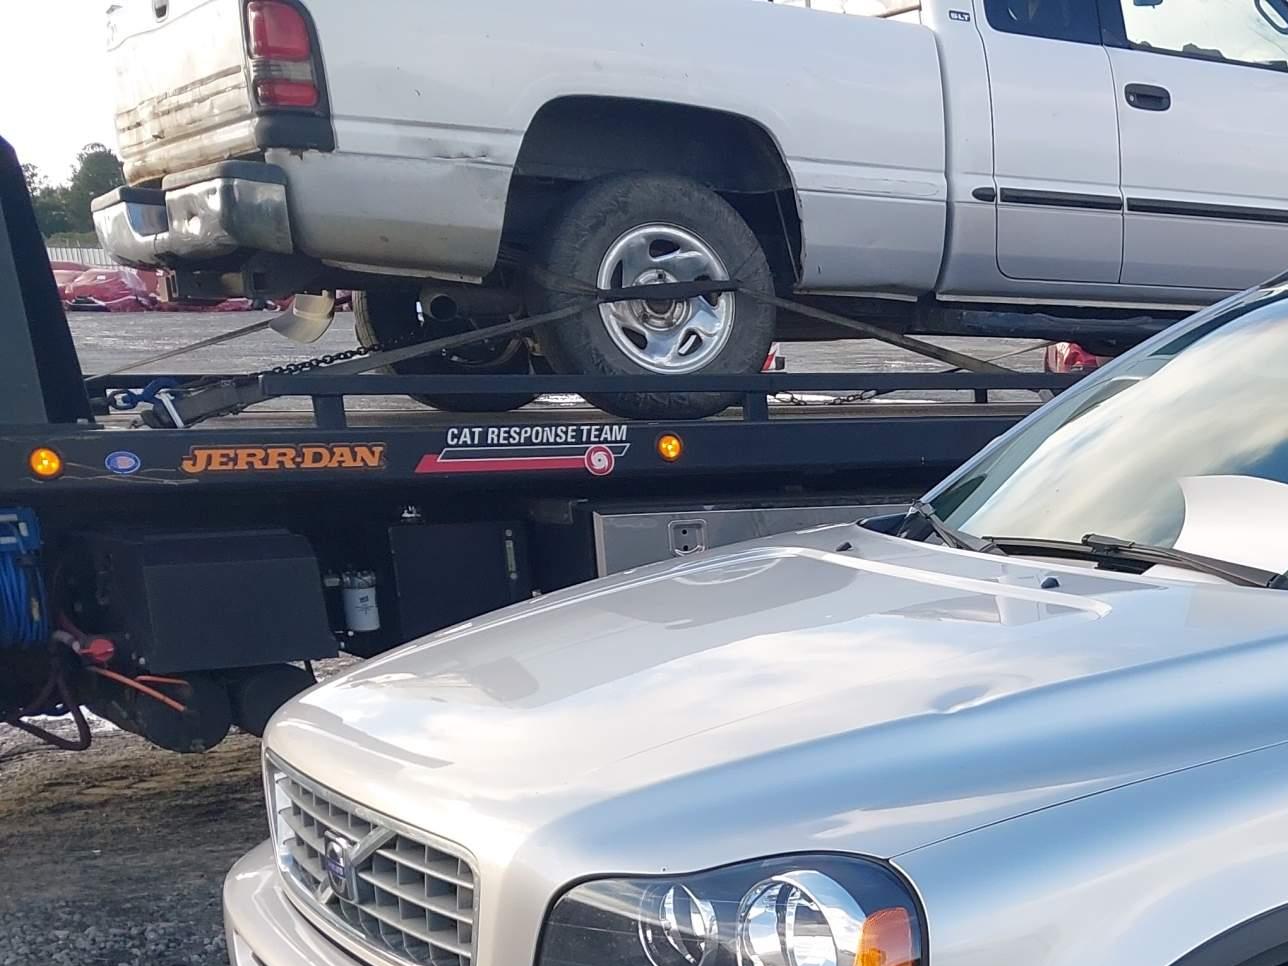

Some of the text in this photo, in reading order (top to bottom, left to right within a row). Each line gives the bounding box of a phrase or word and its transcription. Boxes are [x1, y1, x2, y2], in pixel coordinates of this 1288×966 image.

[447, 424, 627, 445] CAT RESPONSE TEAM
[181, 445, 385, 473] JERR-DAN
